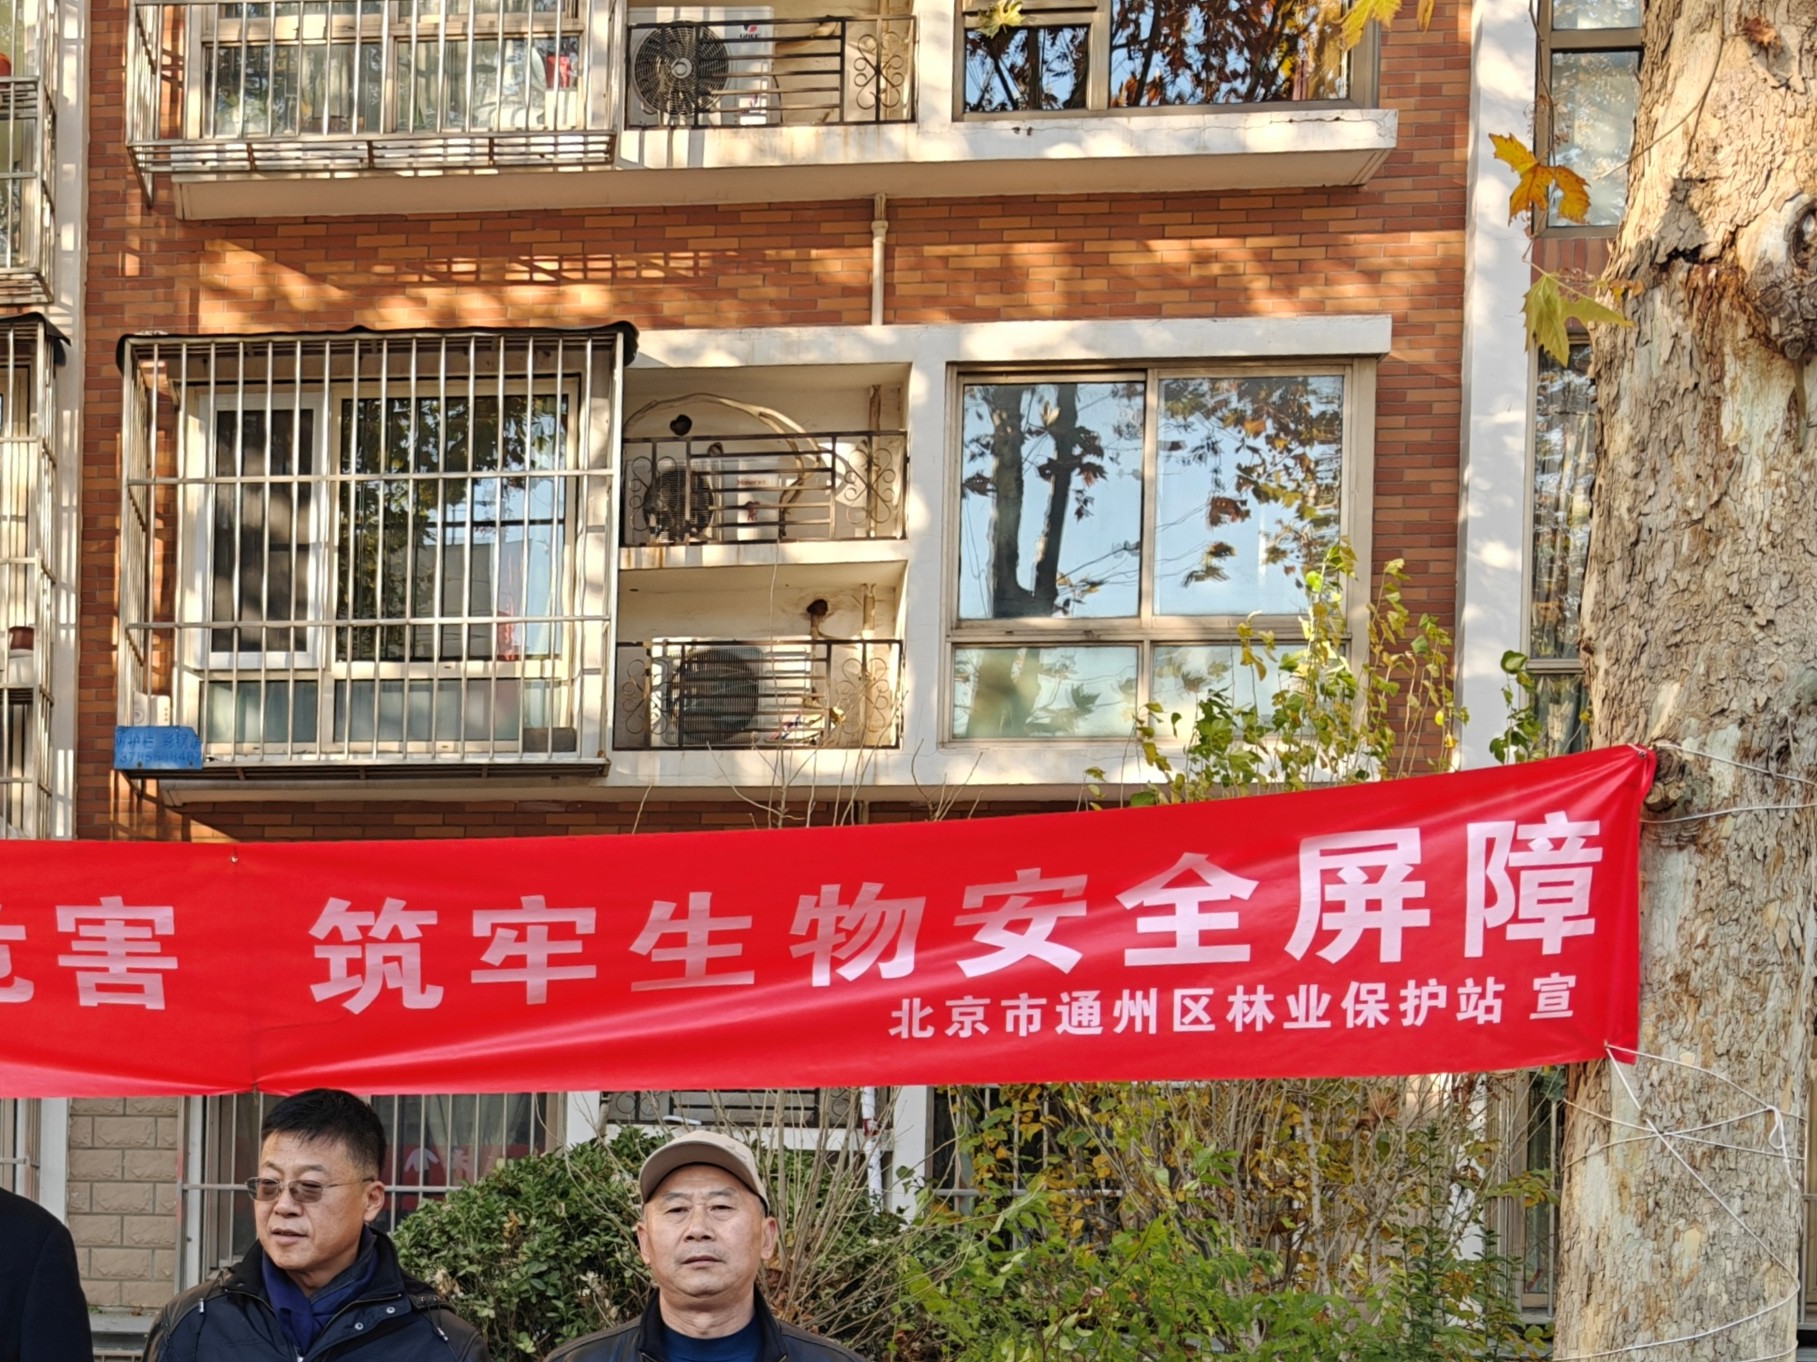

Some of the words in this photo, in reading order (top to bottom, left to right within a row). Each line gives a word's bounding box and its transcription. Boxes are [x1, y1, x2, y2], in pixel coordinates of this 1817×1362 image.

[306, 809, 1605, 1016] 筑牢生物安全屏障
[888, 976, 1506, 1040] 北京市通州区林业保护站
[1527, 972, 1577, 1021] 宣
